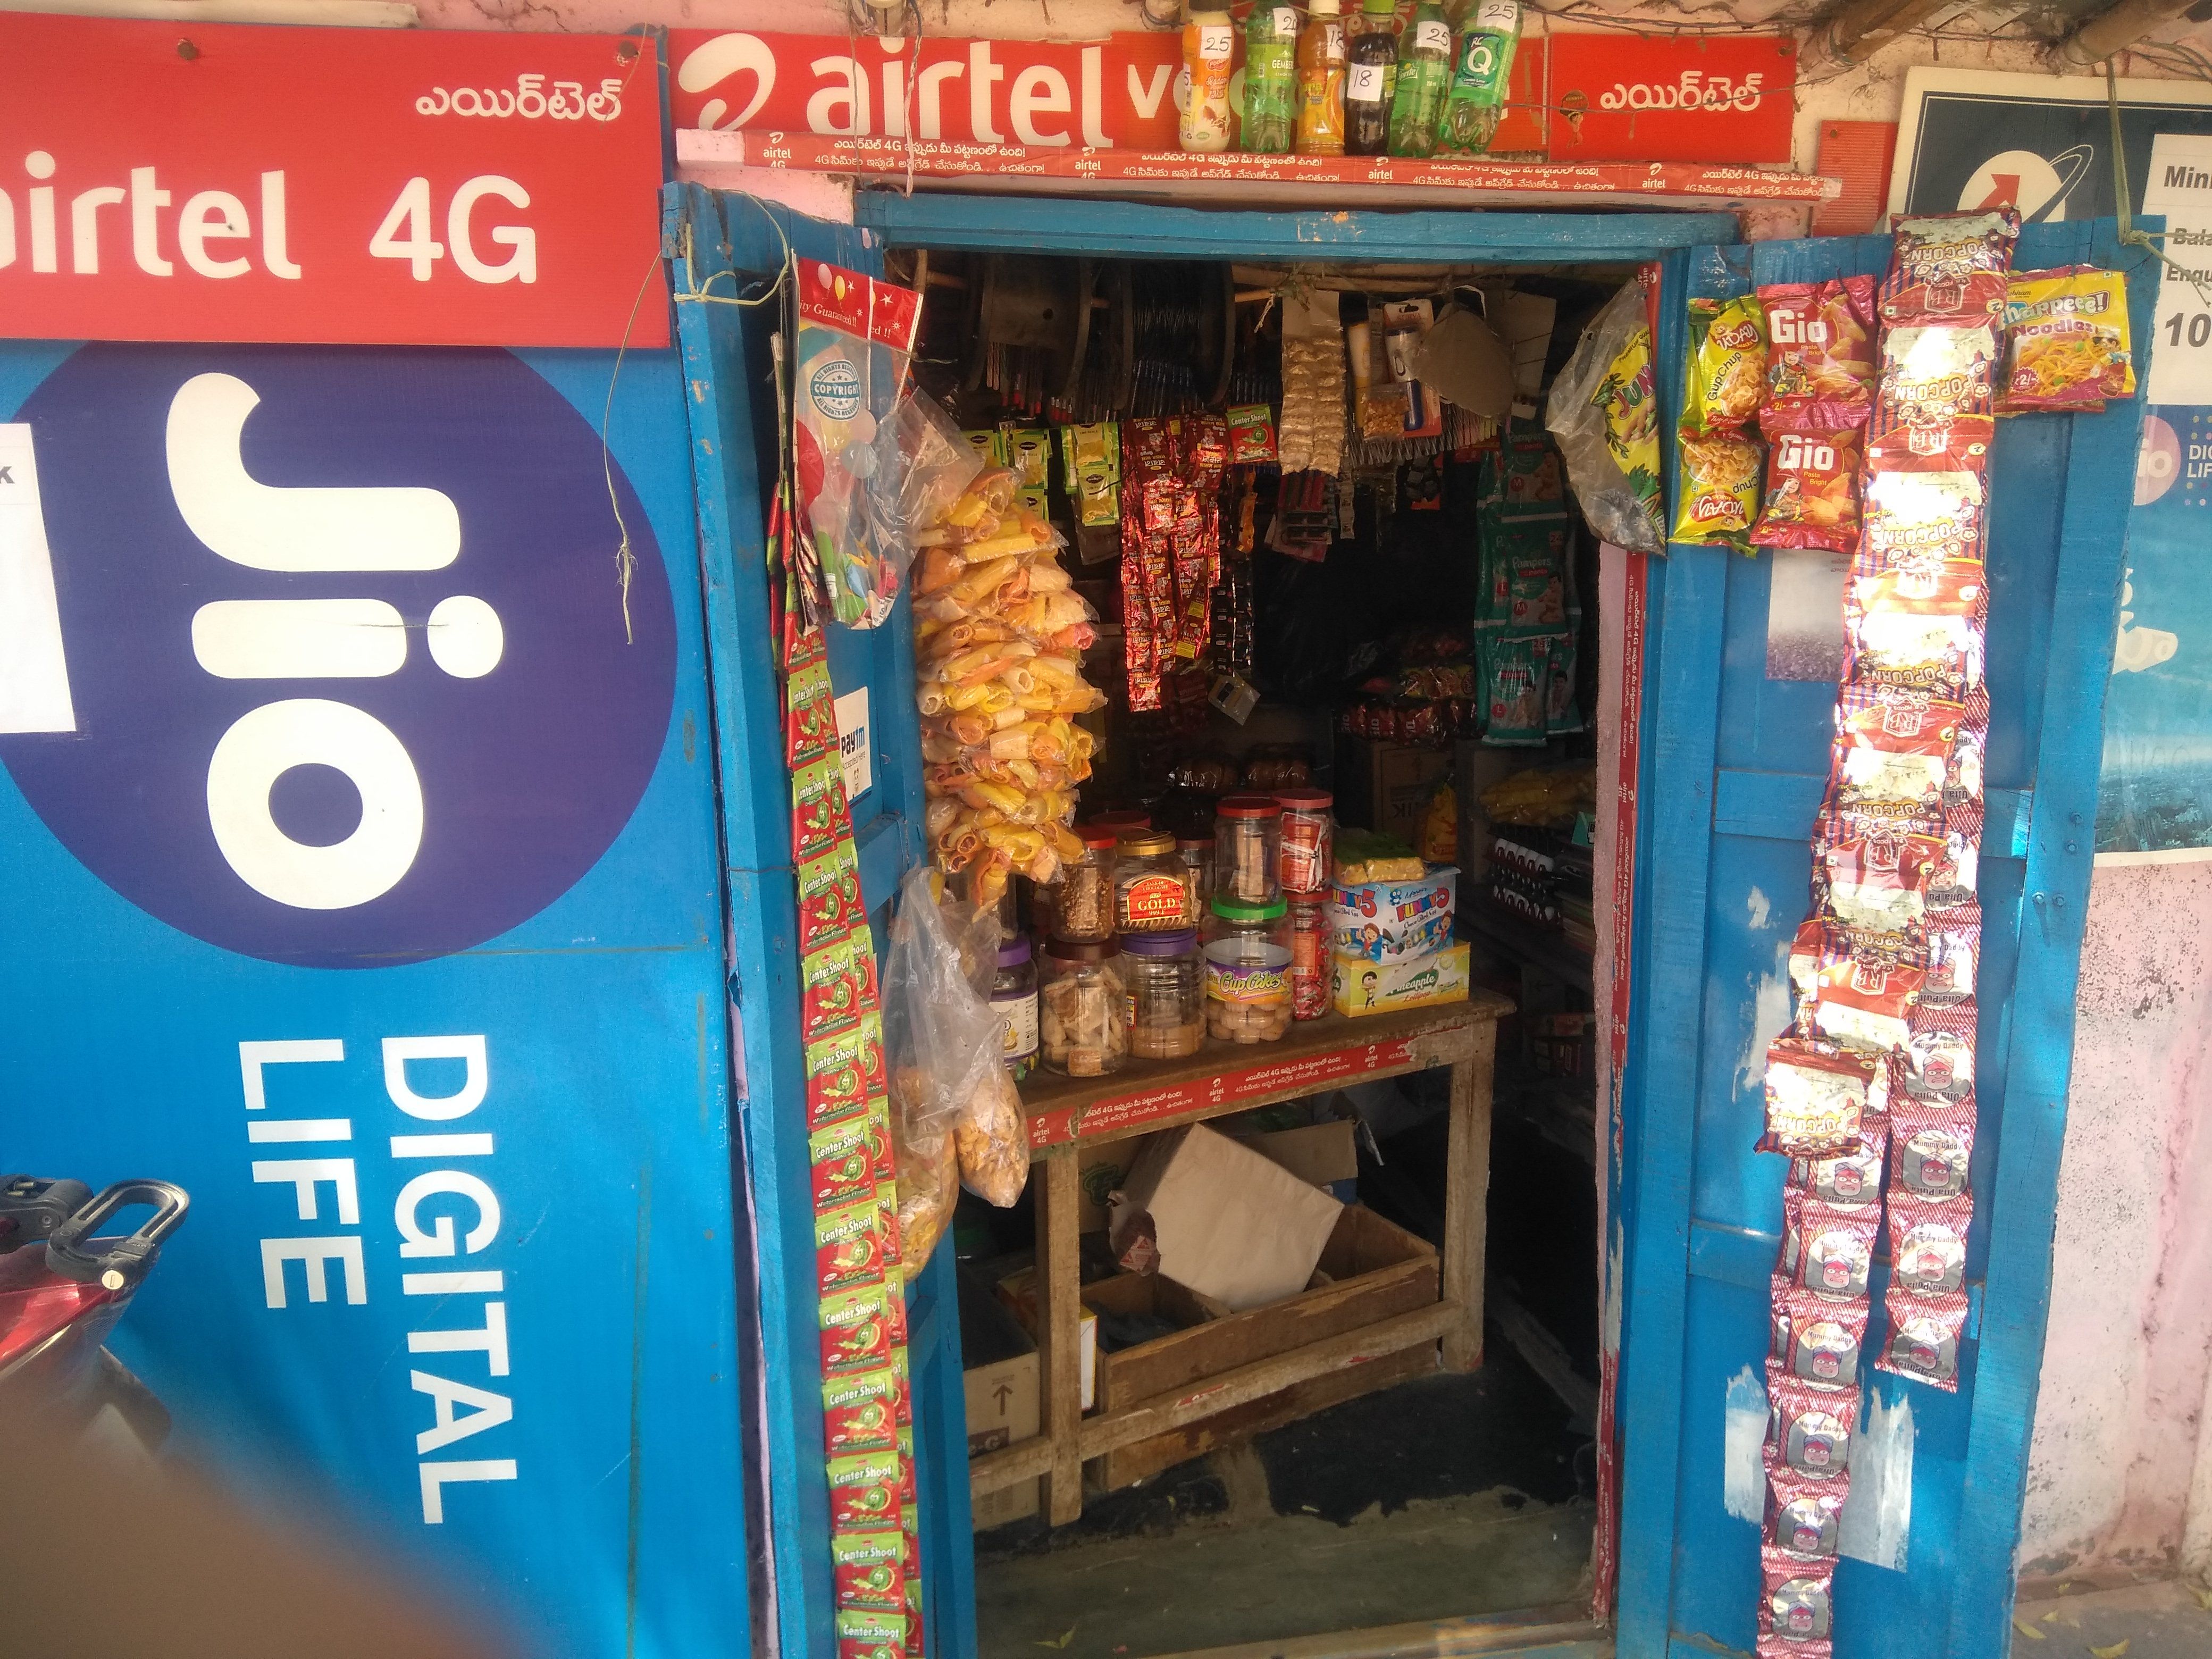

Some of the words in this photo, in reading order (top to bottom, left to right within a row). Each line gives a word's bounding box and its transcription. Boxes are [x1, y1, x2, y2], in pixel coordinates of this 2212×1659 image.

[1484, 4, 1514, 20] 25
[1205, 37, 1231, 52] 25
[1427, 28, 1451, 46] 25
[1468, 46, 1492, 76] Q
[1354, 70, 1372, 88] 18
[415, 74, 623, 121] ఎయిర్‌టెల్
[807, 37, 1113, 148] airtel
[763, 148, 792, 159] airtel
[884, 140, 902, 152] 4G
[815, 154, 830, 165] 4G
[1075, 160, 1101, 171] airtel
[1122, 166, 1136, 177] 4G
[1368, 170, 1394, 181] airtel
[1744, 170, 1759, 180] 4G
[1412, 176, 1426, 186] 4G
[1641, 179, 1666, 189] airtel
[1685, 184, 1697, 193] 4G
[369, 175, 537, 284] 4G
[1910, 240, 1989, 262] POPCORN
[1770, 309, 1828, 345] Gio
[2011, 319, 2094, 339] Noodles
[2165, 312, 2212, 347] 10
[814, 384, 858, 395] COPYRIGHT
[1894, 376, 1974, 401] POPCORN
[1231, 414, 1250, 425] Center
[1249, 413, 1267, 423] Shoot
[1777, 433, 1835, 471] Gio
[2138, 438, 2173, 479] io
[1880, 521, 1963, 546] POPCORN
[165, 372, 504, 909] Jio
[1870, 664, 1946, 685] POPCORN
[842, 754, 858, 770] Accepted
[1851, 802, 1926, 818] POPCORN
[804, 877, 822, 894] Center
[1138, 898, 1176, 911] GOLD
[1333, 888, 1362, 909] UNNY
[1360, 889, 1377, 918] 5
[1396, 893, 1437, 923] FUNNY
[809, 967, 830, 984] Center
[829, 958, 849, 975] Shoot
[1220, 971, 1246, 996] Cup
[1245, 970, 1283, 991] Cakes
[1915, 1042, 1941, 1051] Mummy
[1942, 1042, 1964, 1051] Daddy
[813, 1055, 835, 1073] Center
[835, 1044, 858, 1062] Shoot
[1364, 1054, 1379, 1063] airtel
[1209, 1087, 1224, 1097] airtel
[1212, 1094, 1221, 1103] 4G
[1033, 1127, 1050, 1137] airtel
[1037, 1135, 1046, 1144] 4G
[816, 1142, 843, 1159] Center
[843, 1130, 865, 1148] Shoot
[1913, 1139, 1939, 1150] Mummy
[1941, 1141, 1962, 1151] Daddy
[239, 1038, 368, 1309] LIFE
[820, 1226, 849, 1244] Center
[849, 1214, 873, 1233] Shoot
[1910, 1233, 1935, 1243] Mummy
[1937, 1235, 1958, 1244] Daddy
[381, 1035, 518, 1524] DIGITAL
[825, 1309, 856, 1326] Center
[856, 1299, 881, 1316] Shoot
[1808, 1331, 1832, 1343] Mummy
[1832, 1335, 1853, 1344] Daddy
[830, 1388, 860, 1405] Center
[860, 1381, 886, 1396] Shoot
[834, 1469, 865, 1485] Center
[865, 1464, 892, 1477] Shoot
[839, 1549, 869, 1562] Center
[870, 1546, 897, 1557] Shoot
[843, 1624, 873, 1637] Center
[874, 1623, 900, 1638] Shoot
